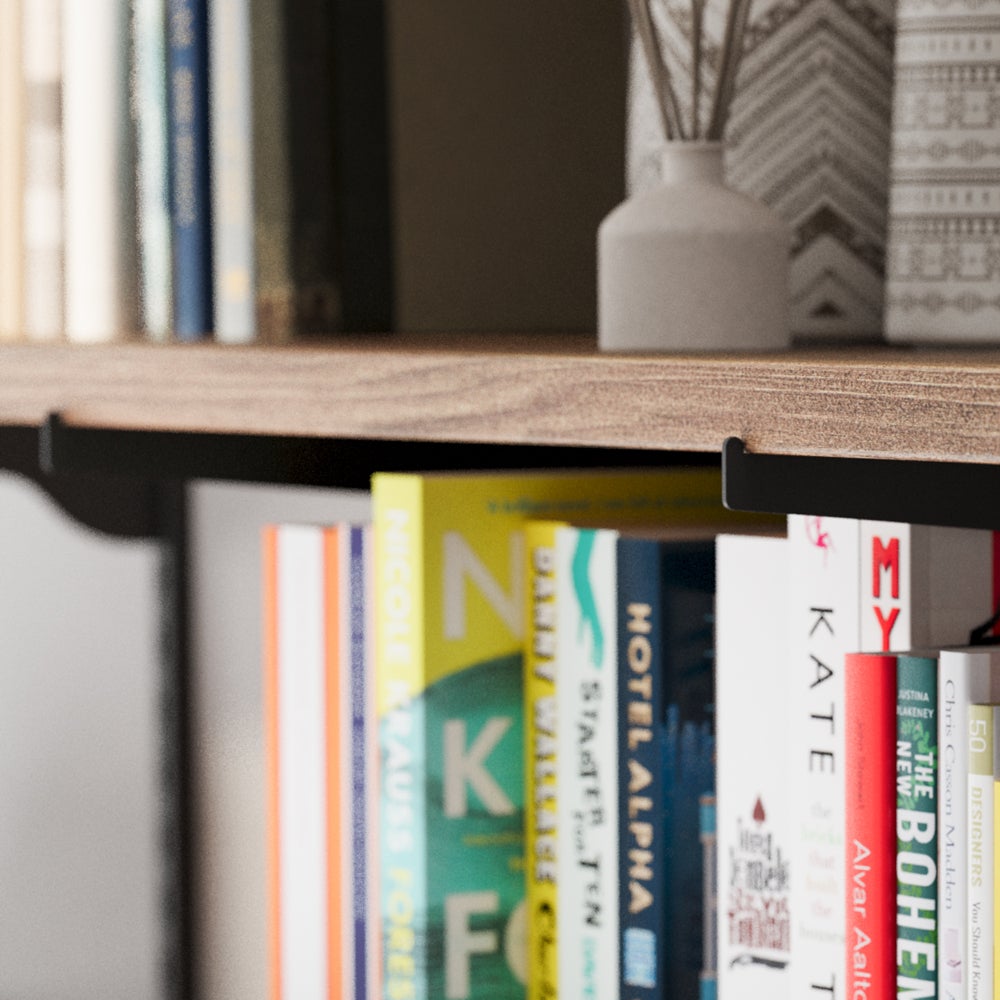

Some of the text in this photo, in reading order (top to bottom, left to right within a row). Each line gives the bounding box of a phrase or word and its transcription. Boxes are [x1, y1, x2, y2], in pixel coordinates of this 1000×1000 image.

[871, 536, 901, 652] MY
[627, 603, 653, 749] HOTEL
[809, 607, 835, 774] KATE
[897, 741, 912, 797] NEW
[914, 752, 934, 799] THE
[969, 720, 986, 753] 50
[628, 759, 653, 914] ALPHA
[945, 679, 956, 910] Chris Casson Madden
[972, 787, 983, 888] DESIGNERS
[853, 839, 871, 919] Alvar
